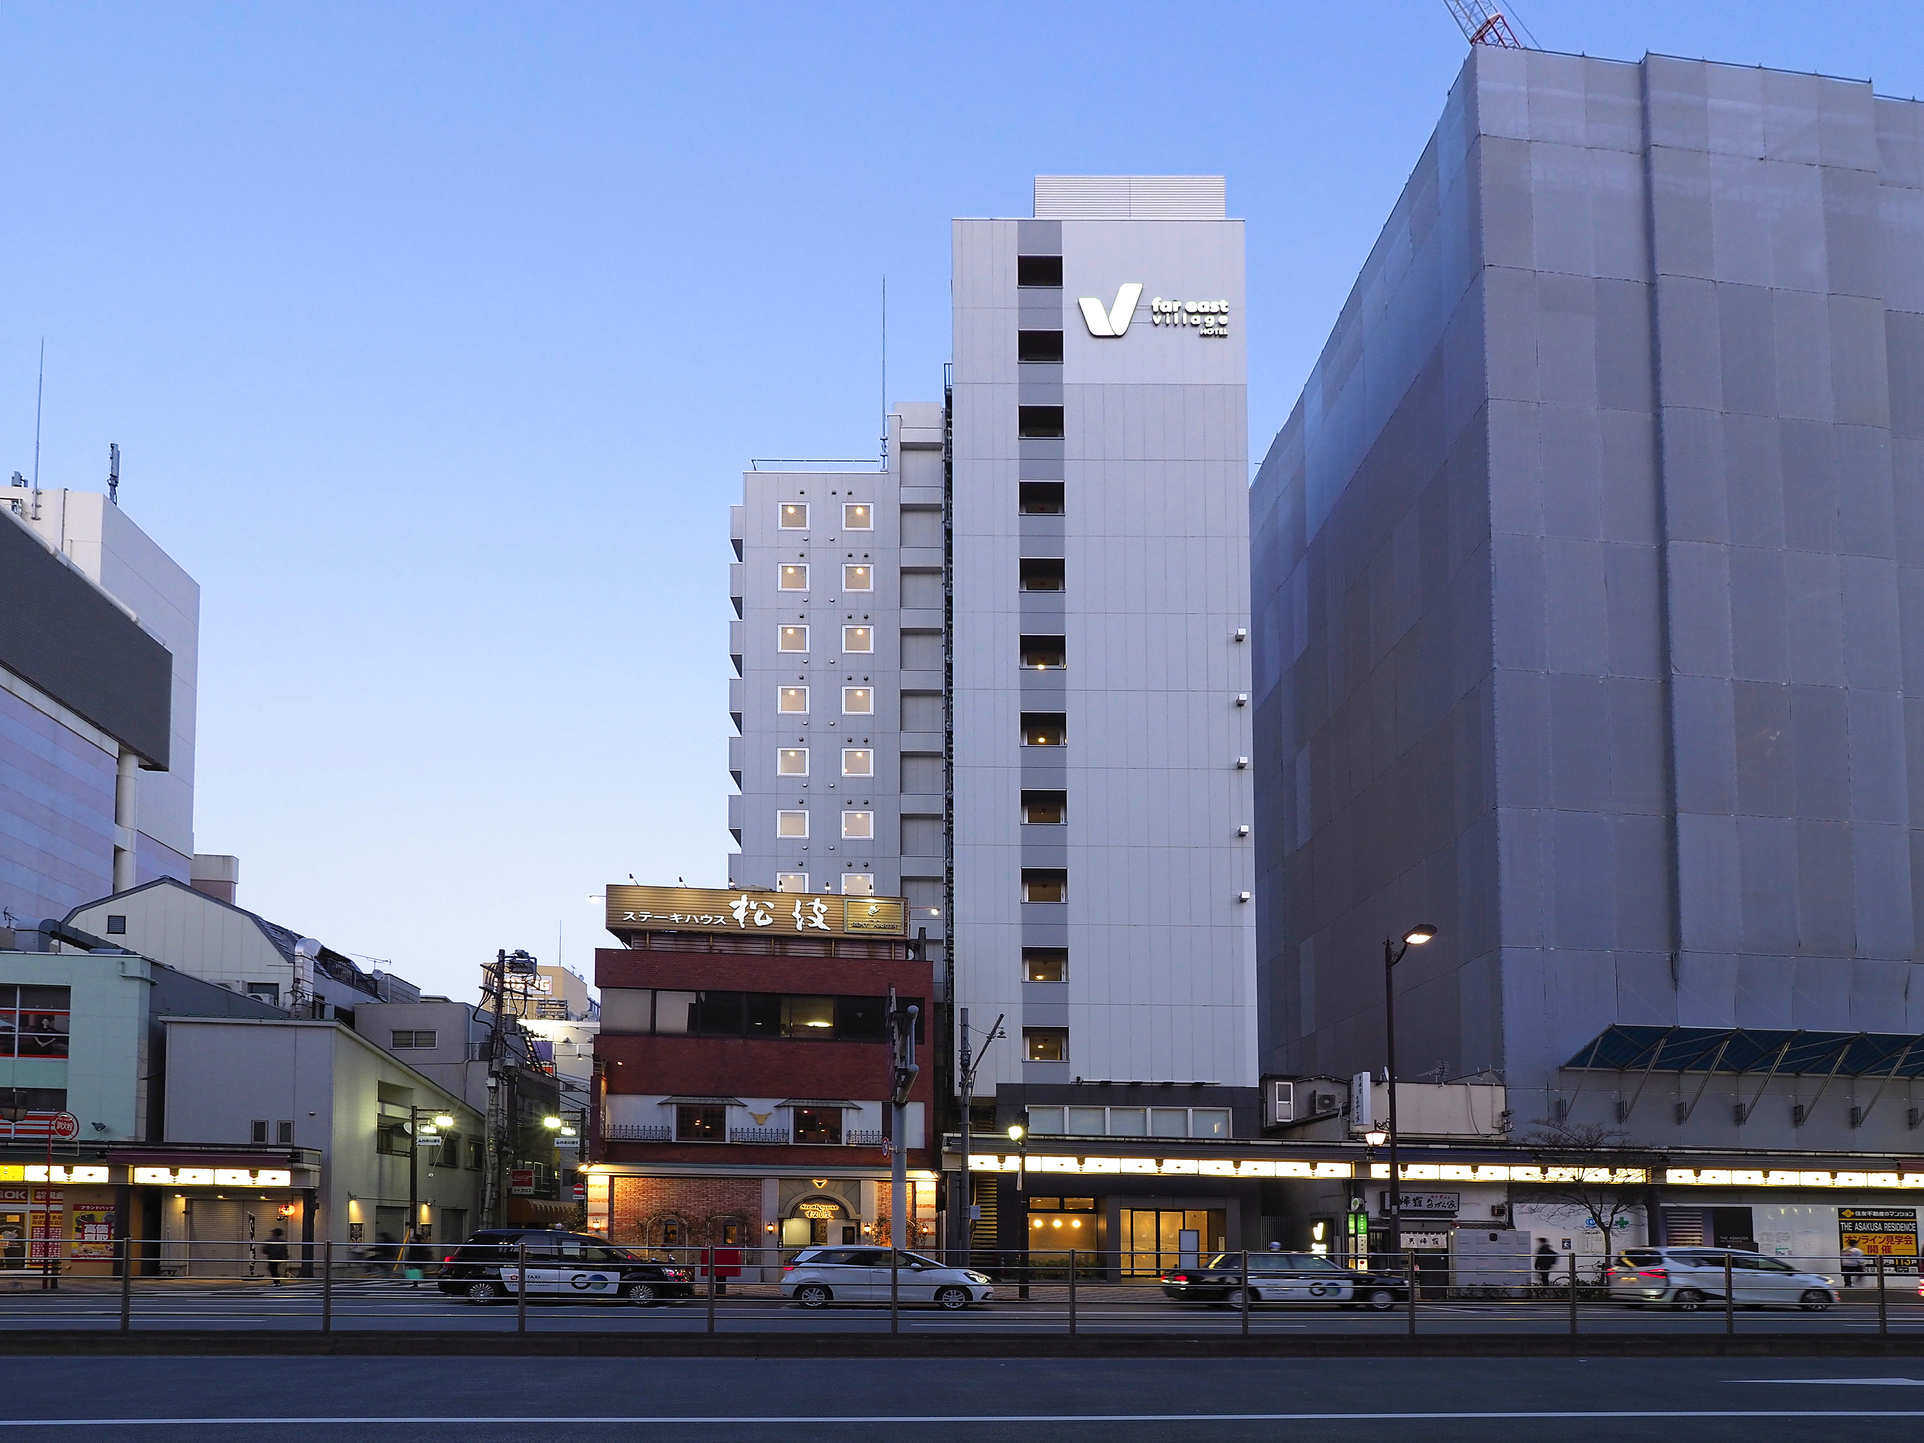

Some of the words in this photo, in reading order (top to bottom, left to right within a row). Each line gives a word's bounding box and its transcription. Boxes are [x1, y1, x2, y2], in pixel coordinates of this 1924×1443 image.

[1151, 296, 1181, 313] far
[1184, 299, 1230, 313] east
[1151, 313, 1229, 327] village
[1199, 327, 1229, 337] HOTEL
[622, 910, 727, 926] ステーキハウス
[1840, 1222, 1853, 1231] THE
[1854, 1222, 1883, 1231] ASAKUSA
[1884, 1222, 1916, 1232] RESIDENCE
[1844, 1234, 1913, 1245] オンライン見学会
[1867, 1244, 1892, 1254] 開催
